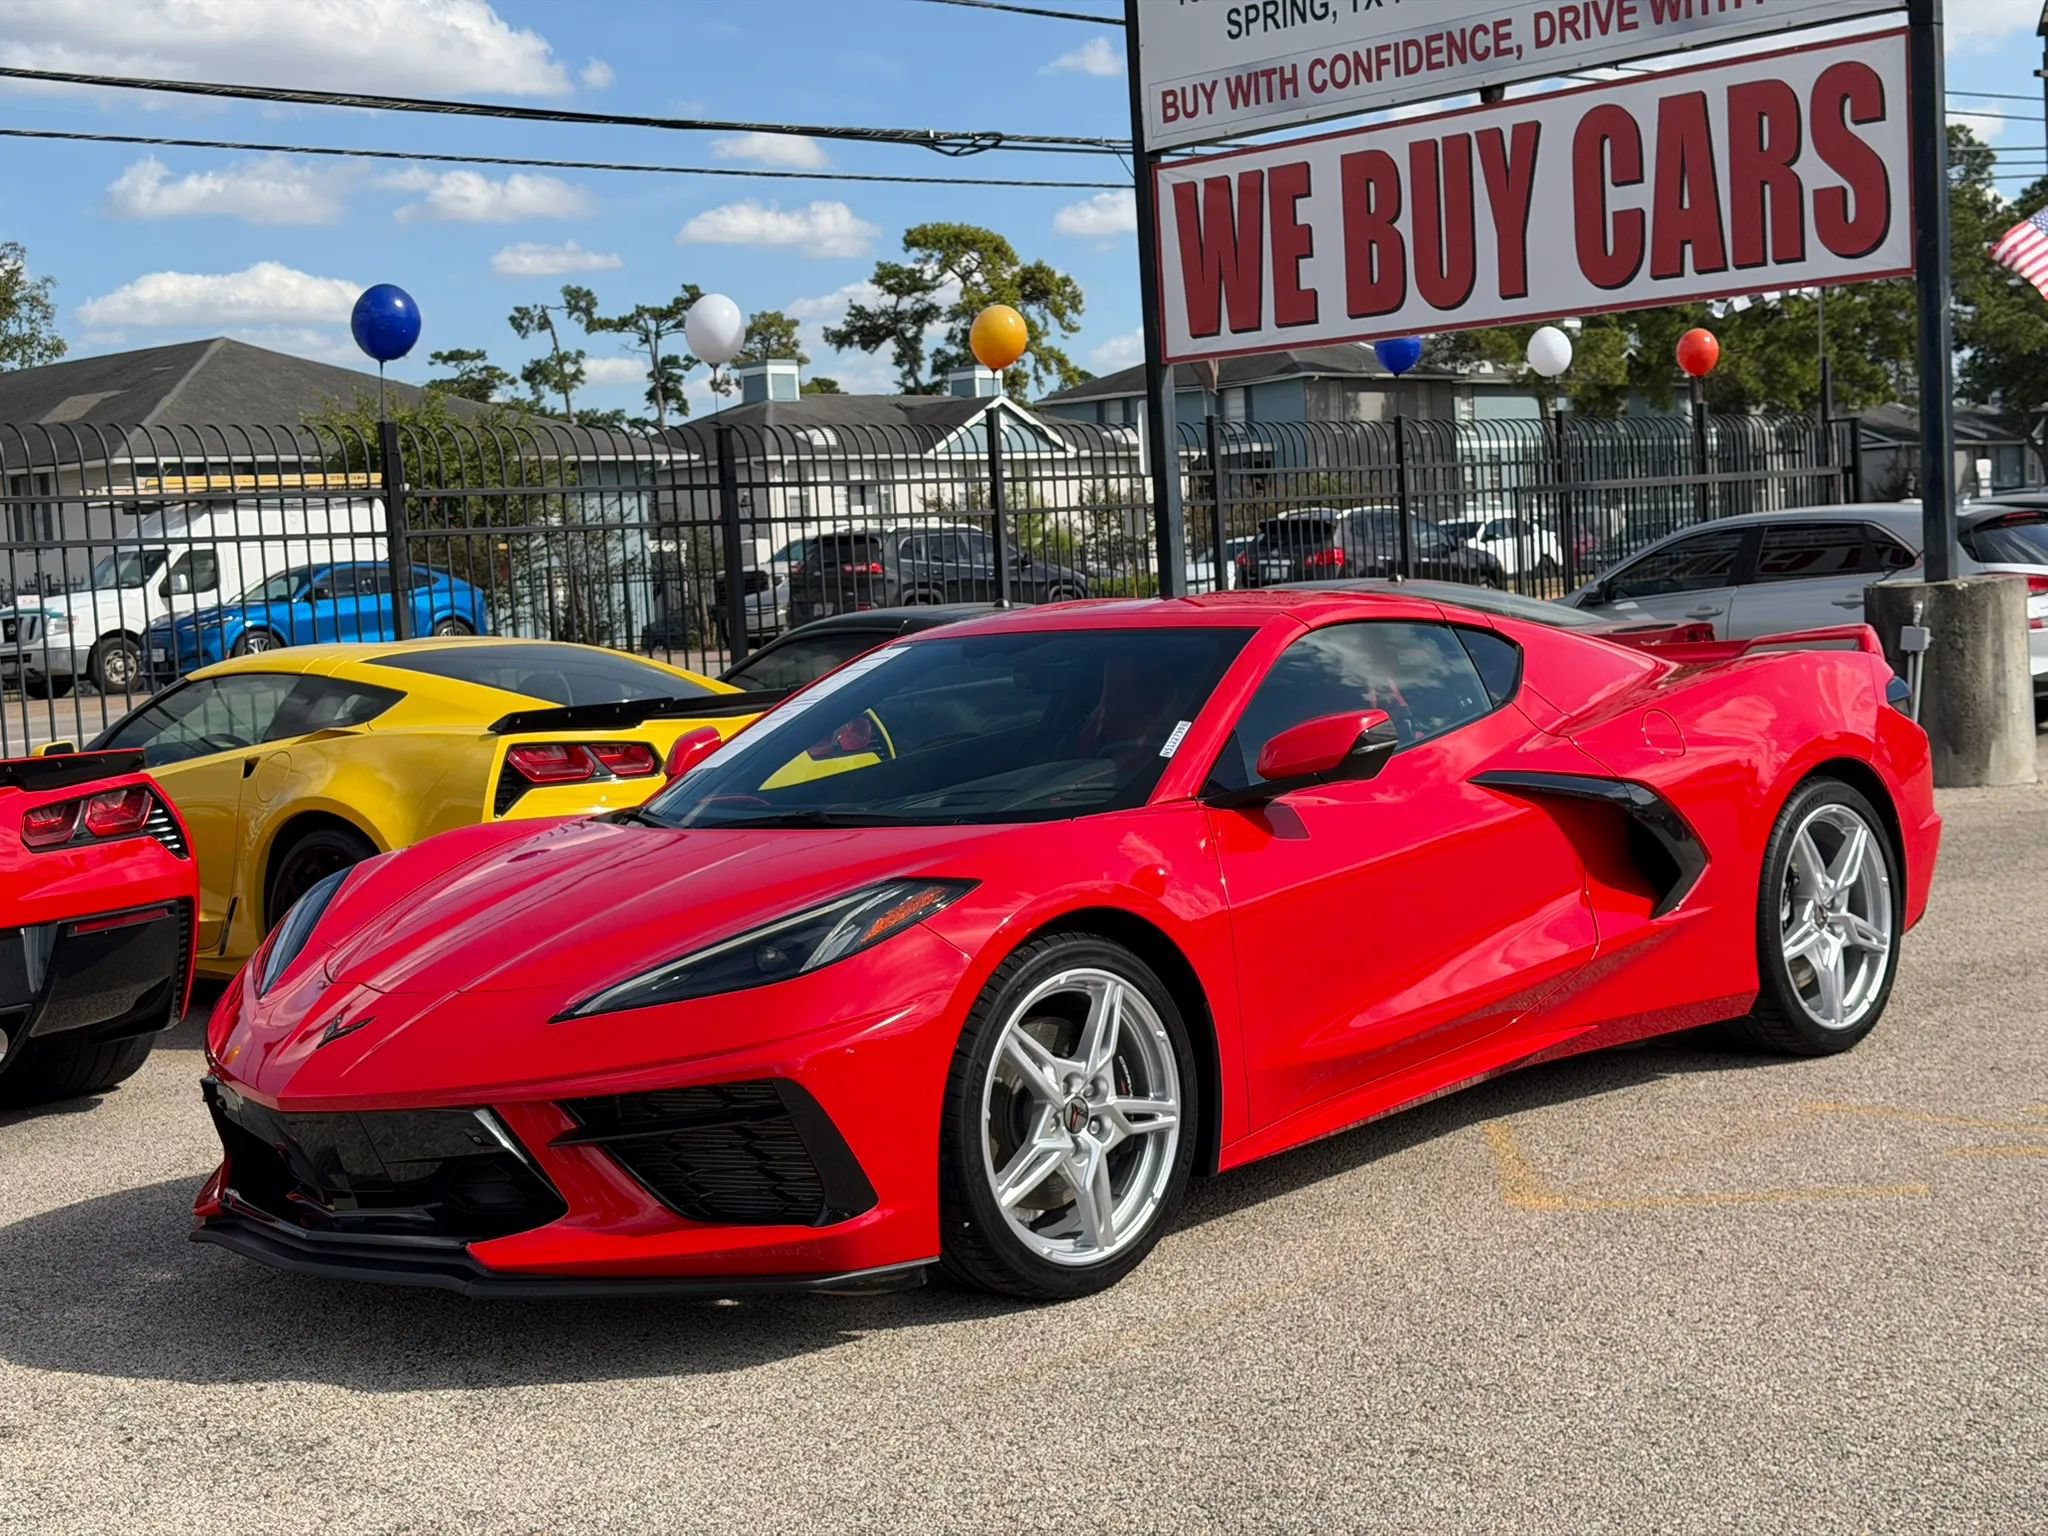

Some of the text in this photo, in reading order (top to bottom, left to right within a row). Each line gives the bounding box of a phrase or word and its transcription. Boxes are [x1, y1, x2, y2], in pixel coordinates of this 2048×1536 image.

[1161, 79, 1219, 124] BUY
[1224, 63, 1300, 110] WITH
[1307, 18, 1523, 95] CONFIDENCE,
[1533, 0, 1640, 50] DRIVE
[1226, 0, 1338, 40] SPRING,
[1172, 60, 1892, 340] WE BUY CARS
